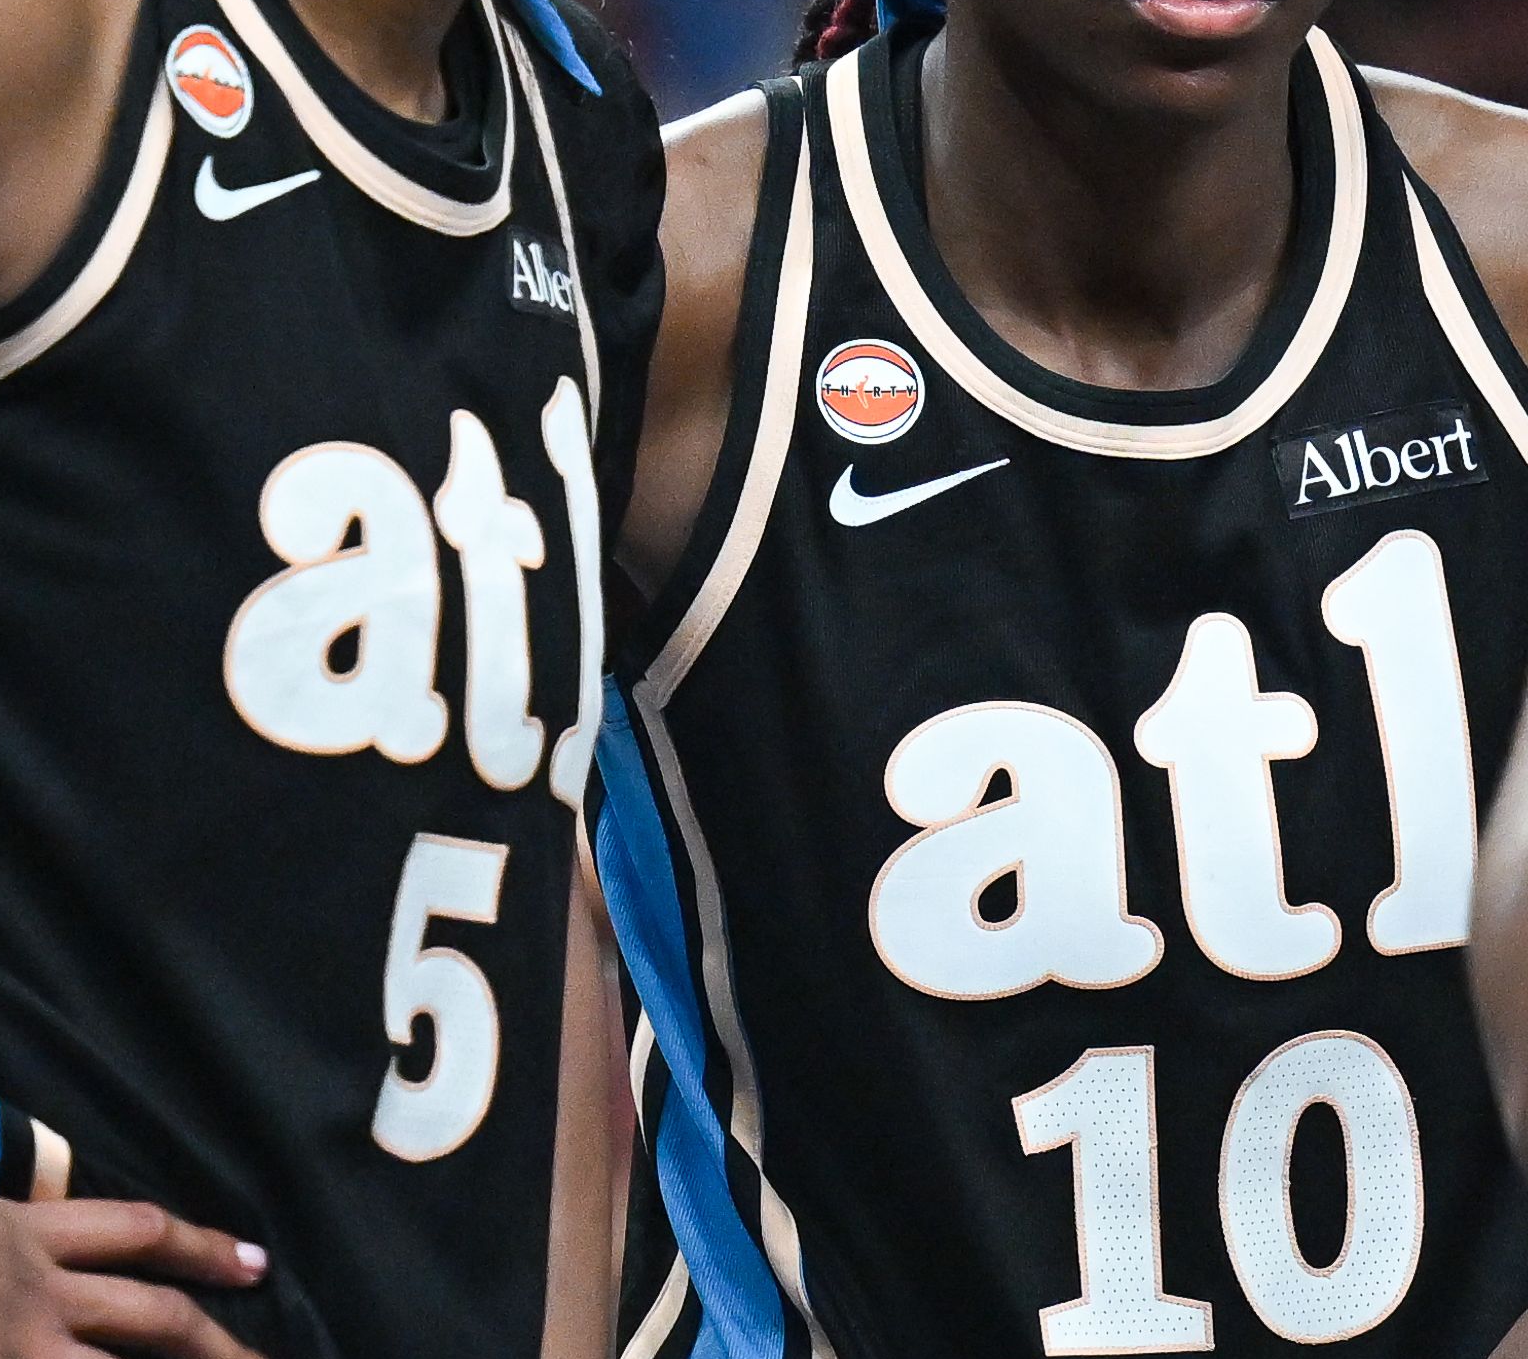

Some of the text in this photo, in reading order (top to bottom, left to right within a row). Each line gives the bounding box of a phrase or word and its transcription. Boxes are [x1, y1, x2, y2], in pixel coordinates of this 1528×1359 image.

[1295, 418, 1479, 507] Albert
[868, 529, 1480, 1002] atl
[371, 832, 510, 1164] 5
[1011, 1029, 1425, 1358] 10
